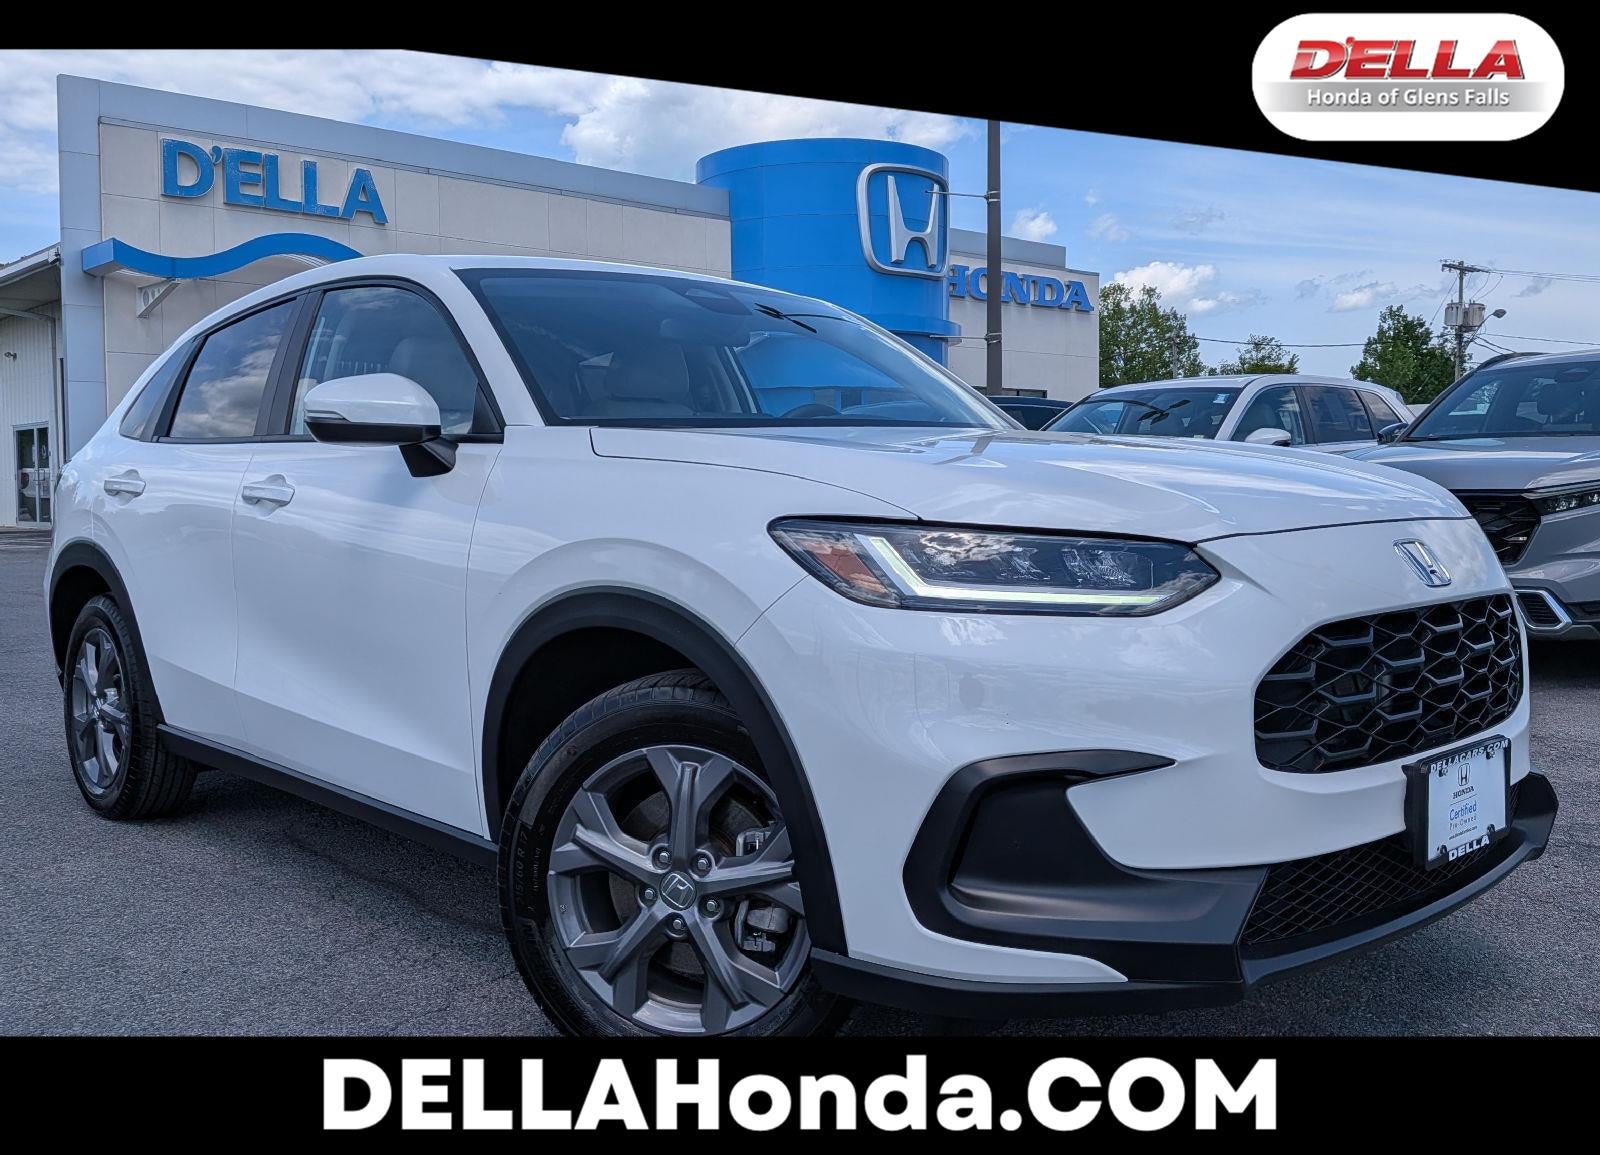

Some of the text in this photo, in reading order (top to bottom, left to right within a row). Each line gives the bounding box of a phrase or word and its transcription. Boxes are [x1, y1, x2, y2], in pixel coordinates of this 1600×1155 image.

[161, 137, 389, 225] D'ELLA
[1452, 786, 1475, 799] HONDA
[1449, 800, 1477, 821] Certified
[1448, 834, 1490, 861] DELLA
